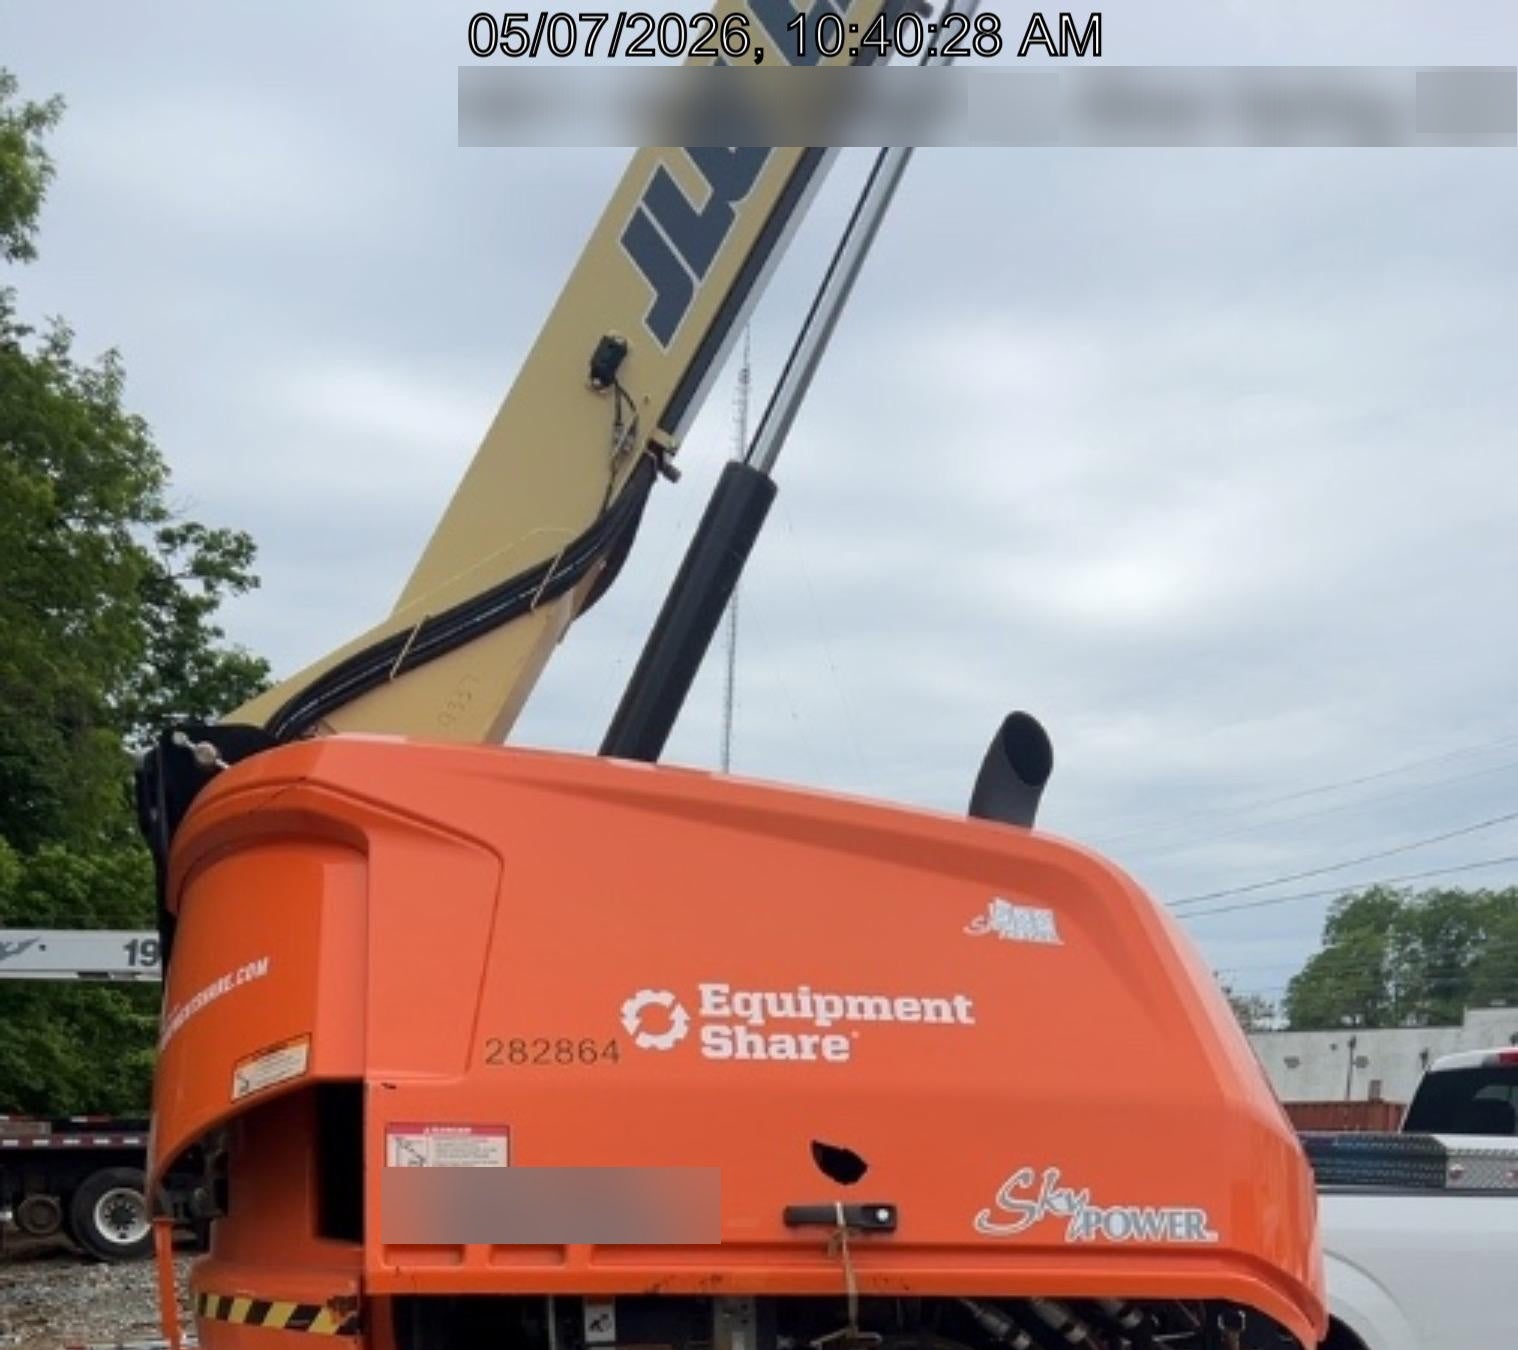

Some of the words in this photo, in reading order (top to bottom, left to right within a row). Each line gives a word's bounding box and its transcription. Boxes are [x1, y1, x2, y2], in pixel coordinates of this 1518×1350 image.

[698, 982, 976, 1027] Equipment
[485, 1038, 621, 1065] 282864
[700, 1024, 851, 1061] Share
